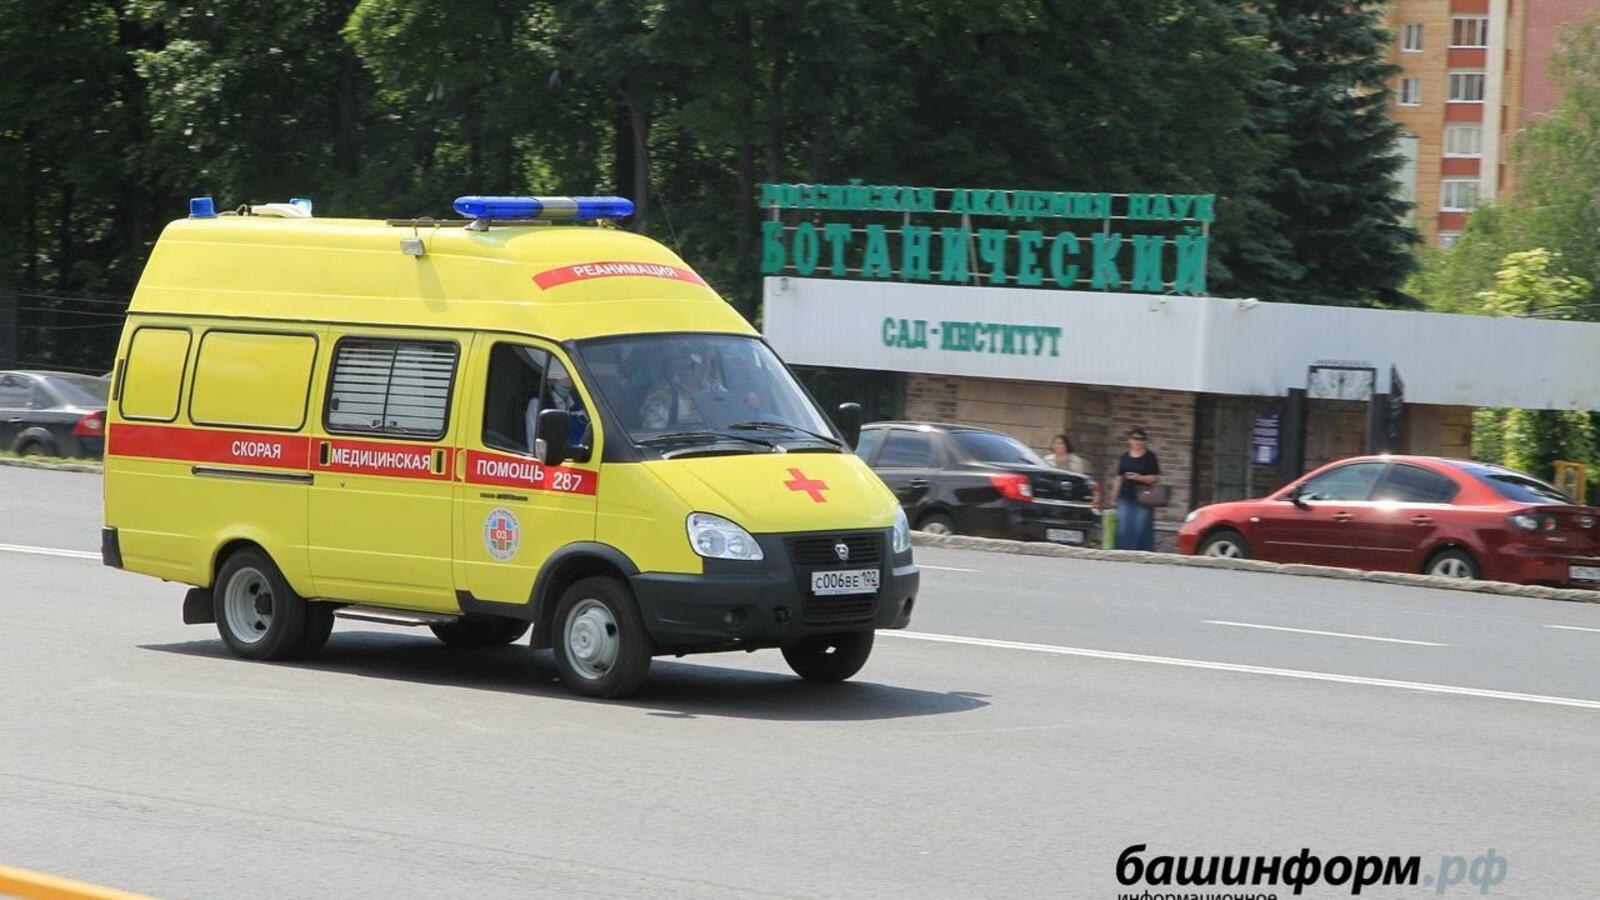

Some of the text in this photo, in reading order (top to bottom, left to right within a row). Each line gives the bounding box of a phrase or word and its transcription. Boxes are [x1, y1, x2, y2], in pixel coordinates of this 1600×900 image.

[760, 178, 1216, 223] РОССИЙСКАЯ АКАДЕМИЯ НАУК
[573, 263, 677, 278] РЕАНИМАЦИЯ
[761, 220, 1208, 296] БОТАНИЧЕСКИЙ
[232, 440, 582, 491] СКОРАЯ МЕДИЦИНСКАЯ ПОМОЩЬ 287
